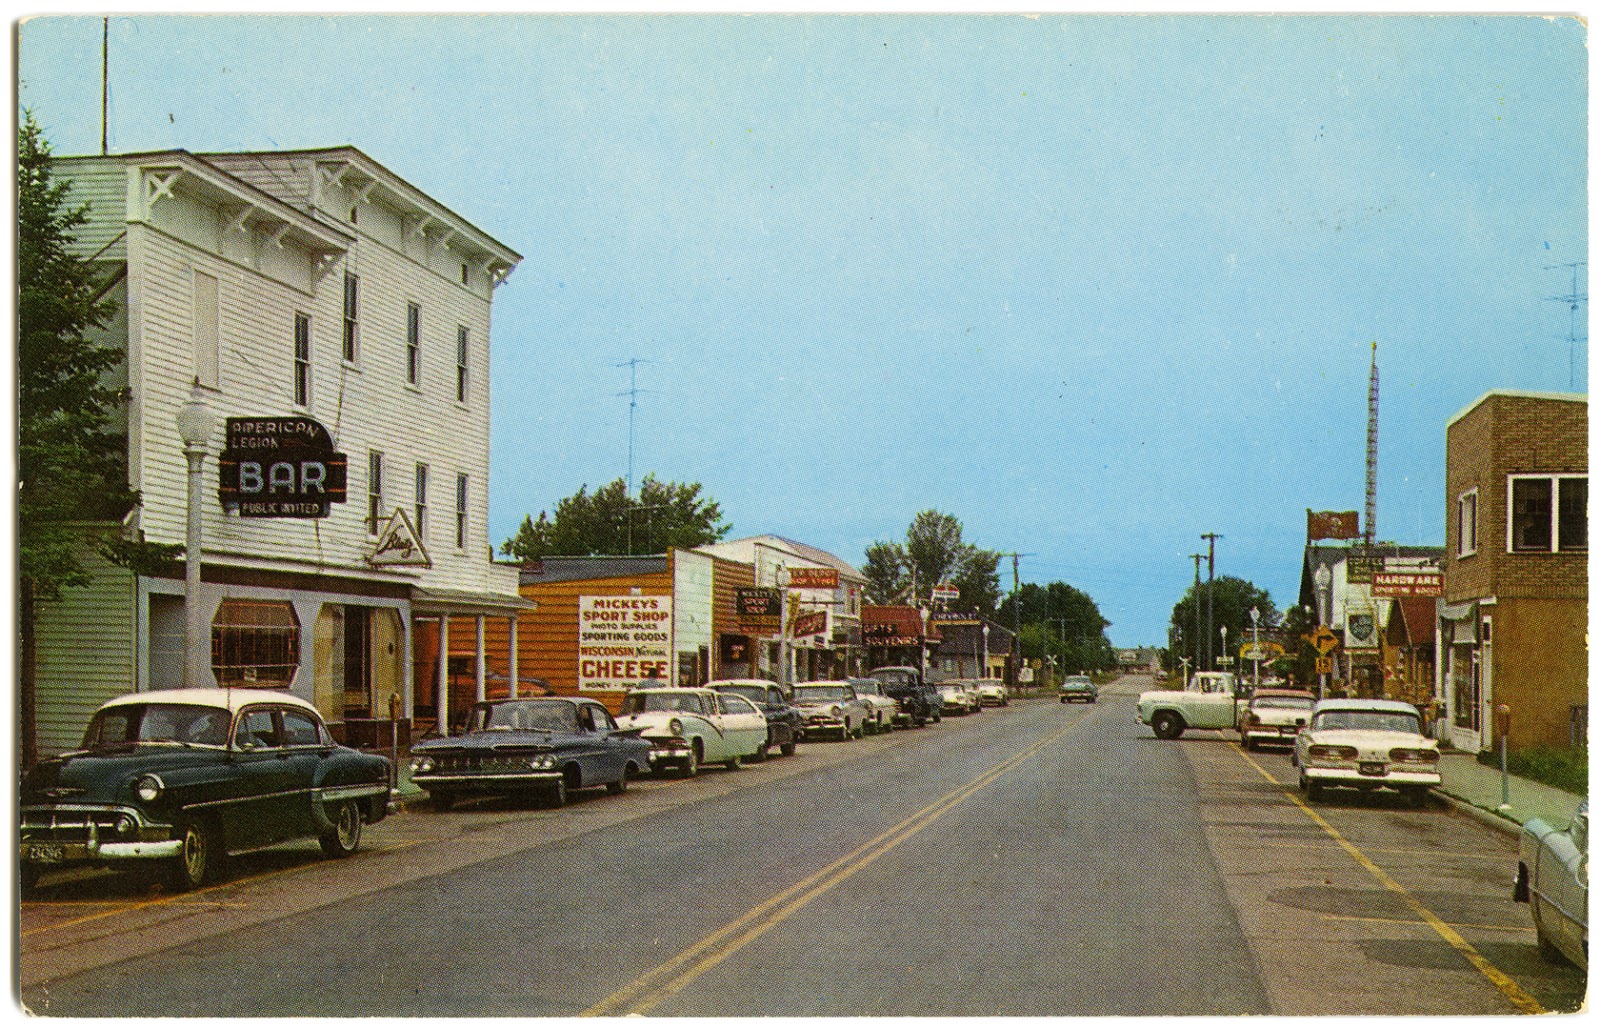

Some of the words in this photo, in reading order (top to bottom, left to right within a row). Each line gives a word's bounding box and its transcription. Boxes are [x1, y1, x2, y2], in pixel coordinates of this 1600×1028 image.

[231, 421, 320, 438] AMERICAN
[231, 437, 280, 449] LEGION
[239, 461, 327, 494] BAR
[242, 502, 278, 515] PUBLIC
[281, 502, 320, 514] INVITED
[1376, 575, 1441, 585] HARDWARE
[593, 599, 659, 609] MICKEYS
[583, 611, 628, 621] SPORT
[632, 611, 669, 621] SHOP
[582, 632, 630, 641] SPORTING
[633, 632, 668, 641] GOODS
[865, 636, 919, 646] SOUVENIRS
[580, 646, 635, 657] WISCONSIN
[581, 660, 669, 679] CHEESE
